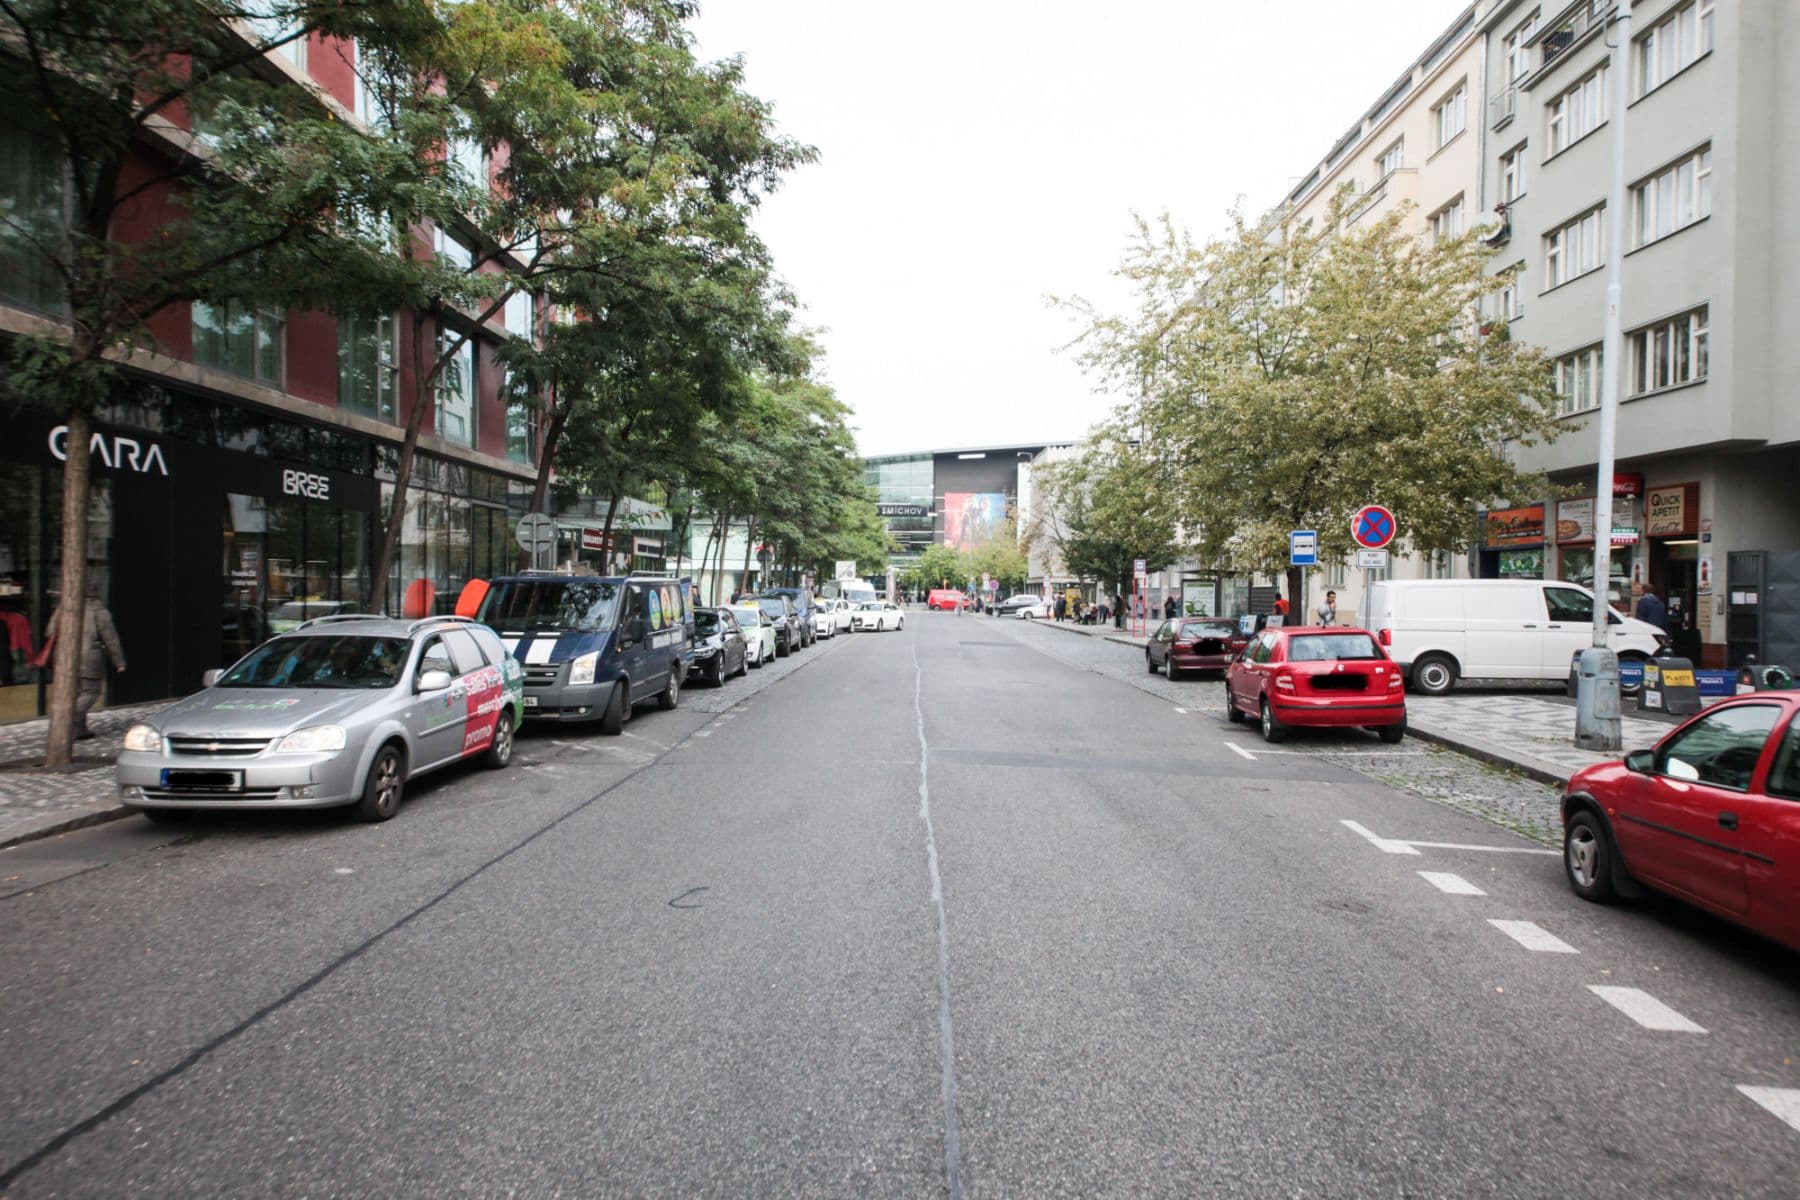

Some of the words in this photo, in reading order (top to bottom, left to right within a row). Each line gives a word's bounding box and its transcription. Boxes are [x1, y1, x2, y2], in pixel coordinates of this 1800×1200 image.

[283, 469, 330, 500] BREE
[1652, 494, 1680, 506] QUICK
[1652, 506, 1680, 517] APETIT
